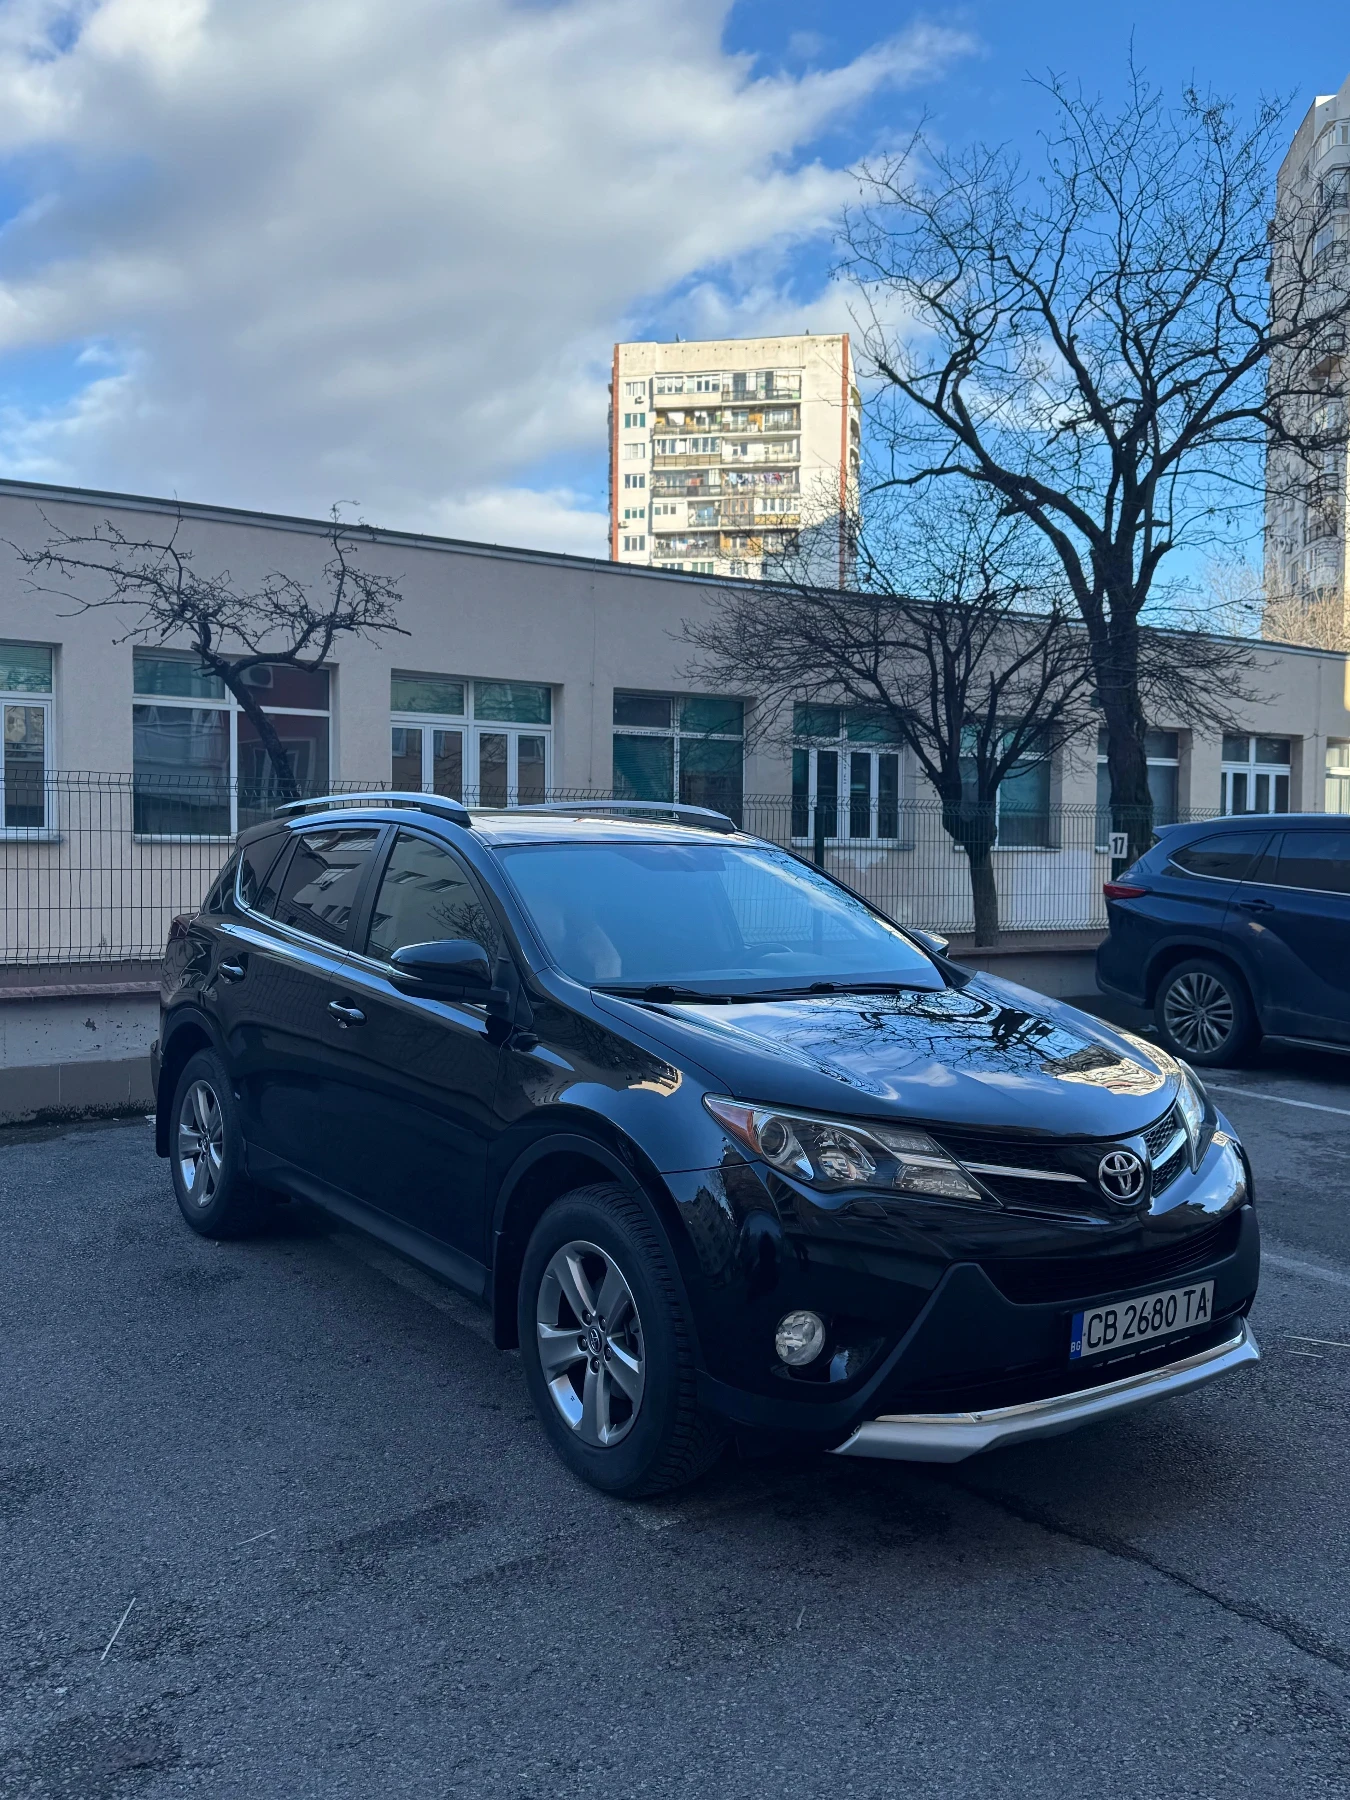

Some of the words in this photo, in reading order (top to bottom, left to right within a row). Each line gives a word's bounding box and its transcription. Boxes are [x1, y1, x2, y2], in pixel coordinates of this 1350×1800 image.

[1112, 836, 1124, 854] 17
[1087, 1310, 1117, 1348] CB
[1122, 1294, 1177, 1340] 2680
[1183, 1287, 1207, 1322] TA
[1070, 1340, 1081, 1352] BG
